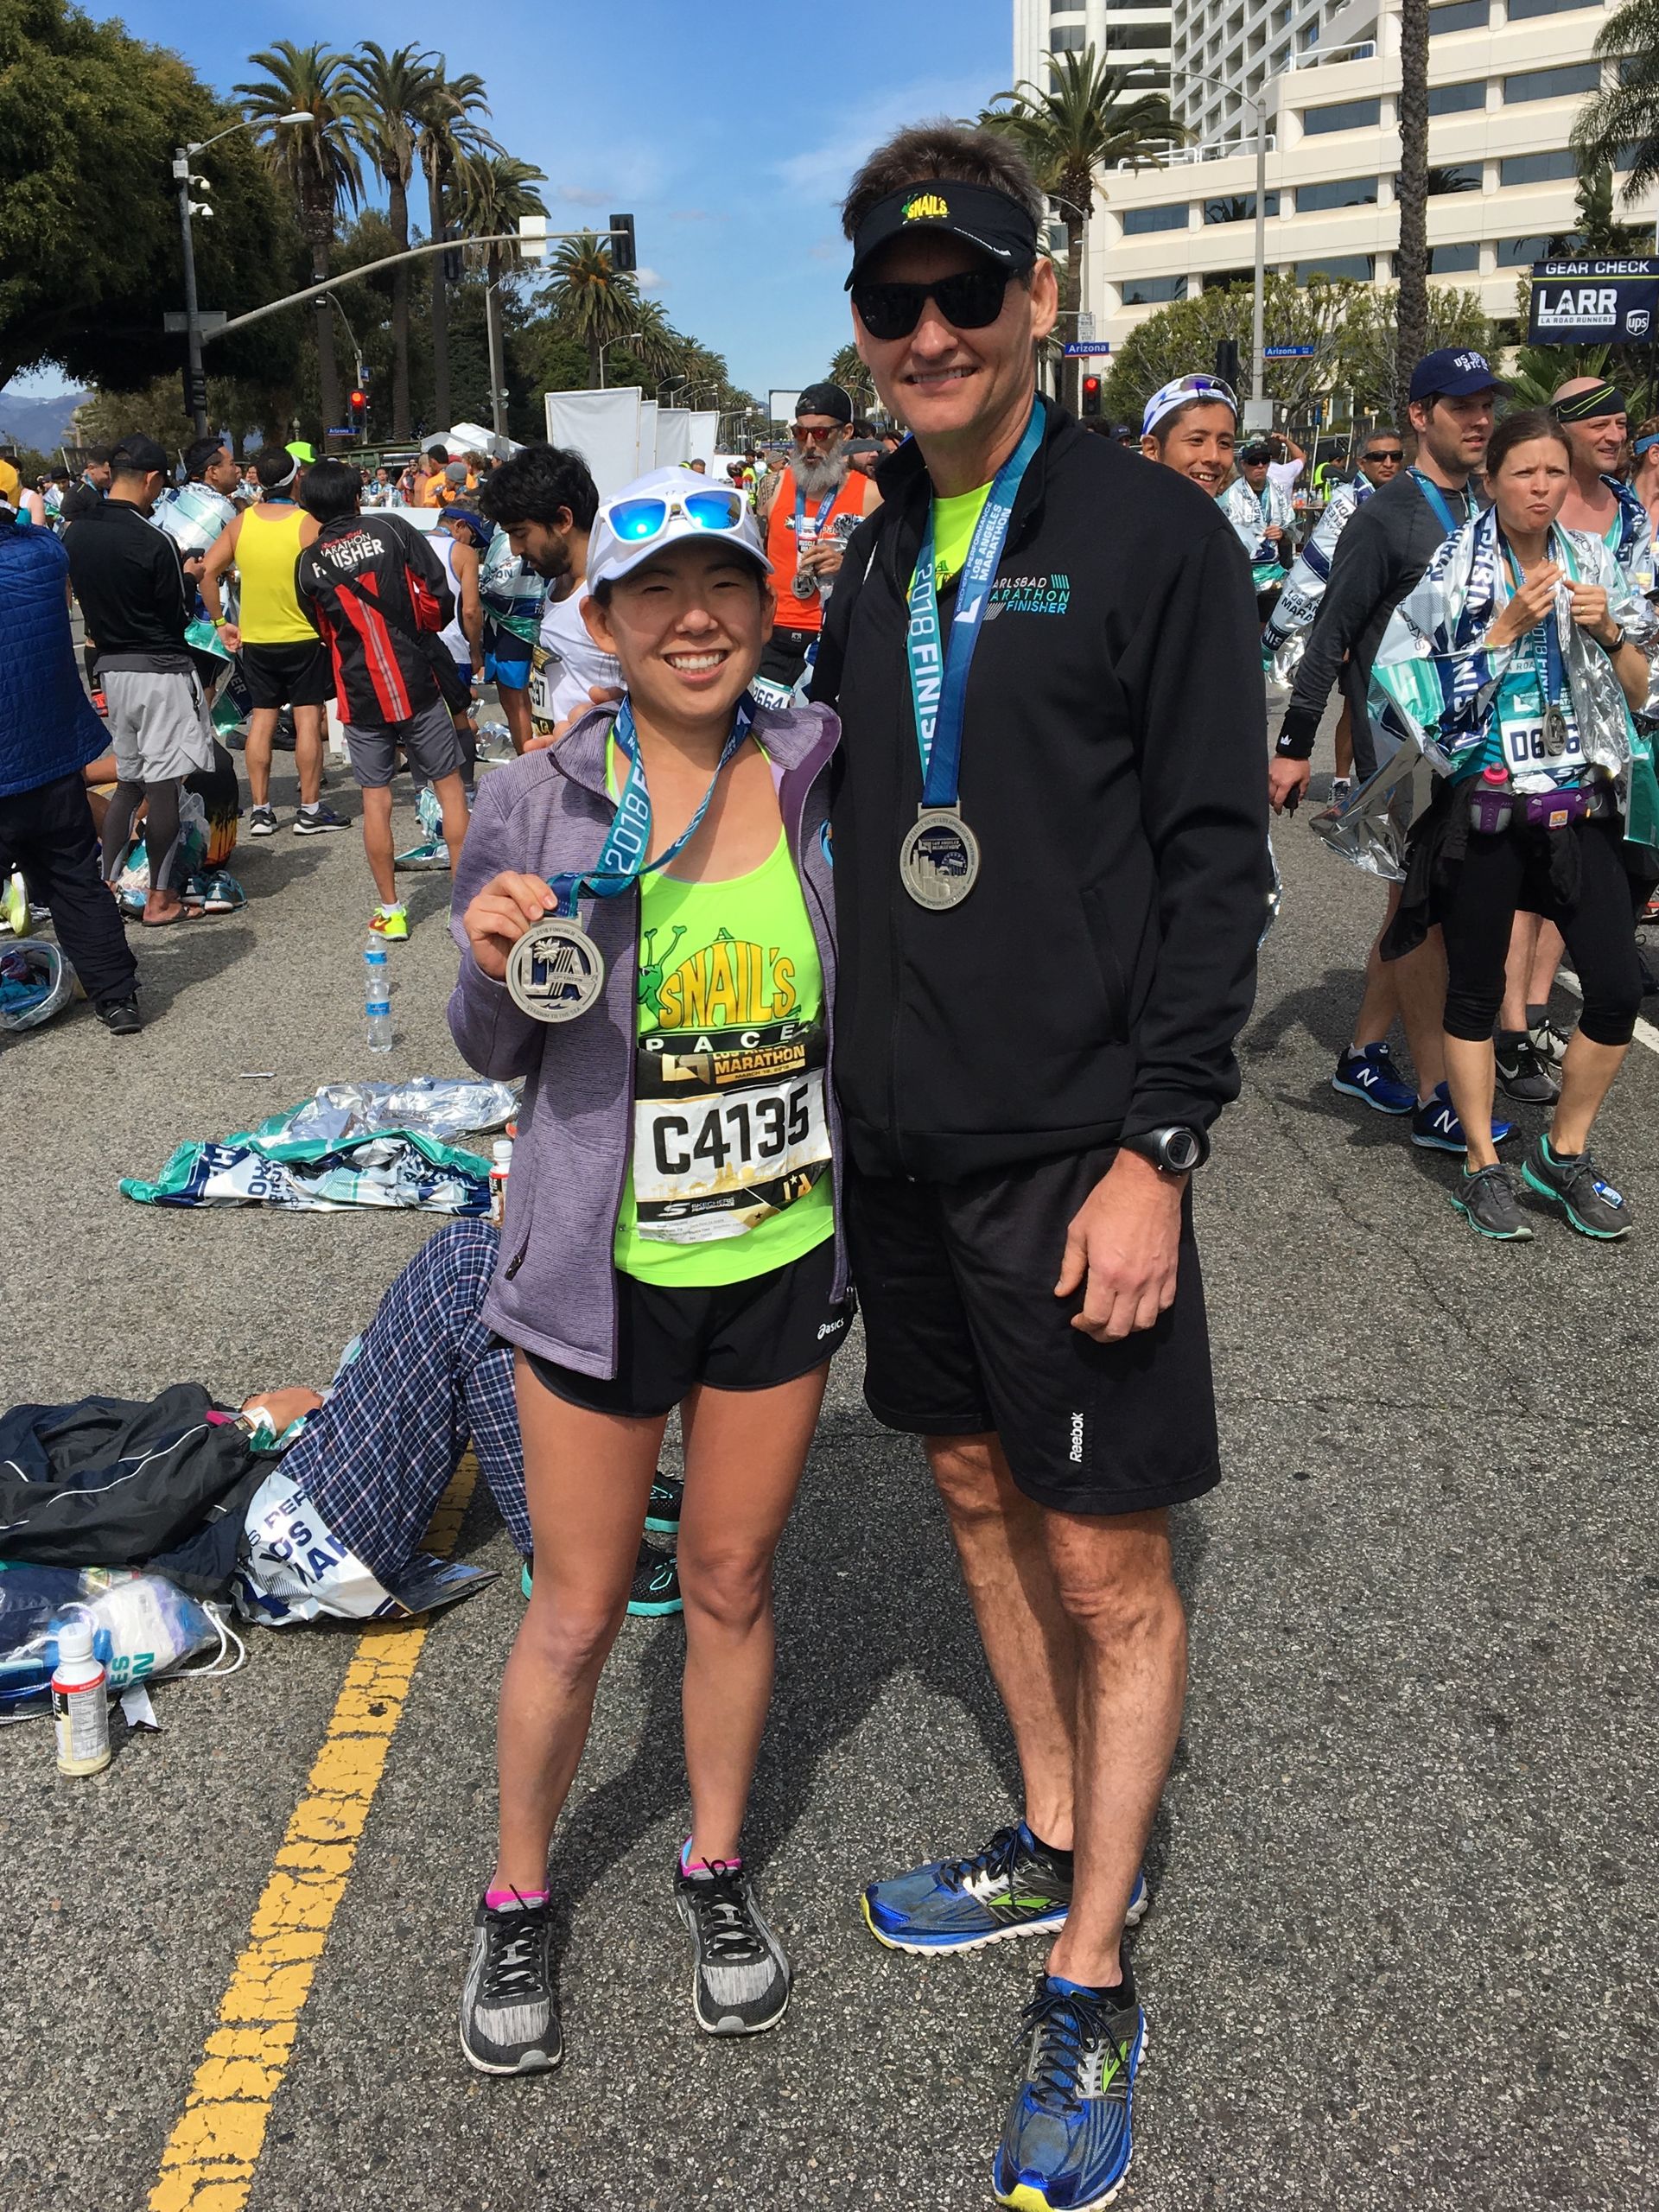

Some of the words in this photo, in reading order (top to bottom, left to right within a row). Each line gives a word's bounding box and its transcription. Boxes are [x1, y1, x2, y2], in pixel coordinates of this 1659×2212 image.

[908, 195, 948, 219] SNAIL'S
[1546, 262, 1589, 275] GEAR
[1595, 260, 1649, 273] CHECK
[1538, 289, 1618, 315] LARR
[1628, 317, 1648, 332] ups
[1068, 344, 1107, 353] Arizona
[1453, 354, 1468, 367] US
[320, 532, 371, 557] ARATHON
[967, 501, 993, 567] PERFORMANCE
[970, 558, 983, 580] LOS
[980, 504, 1002, 555] ANGELES
[978, 508, 1012, 581] MARATHON
[989, 588, 1071, 602] ARATHON
[992, 576, 1047, 589] ARLSBAD
[911, 563, 935, 637] 2018
[1006, 600, 1067, 614] FINISHER
[605, 792, 649, 875] 2018
[716, 927, 734, 940] A
[658, 947, 796, 1028] SNAIL'S
[714, 1036, 806, 1075] MARATHON
[652, 1084, 809, 1175] C4135
[822, 1317, 844, 1337] asics
[1069, 1412, 1084, 1462] Reebok
